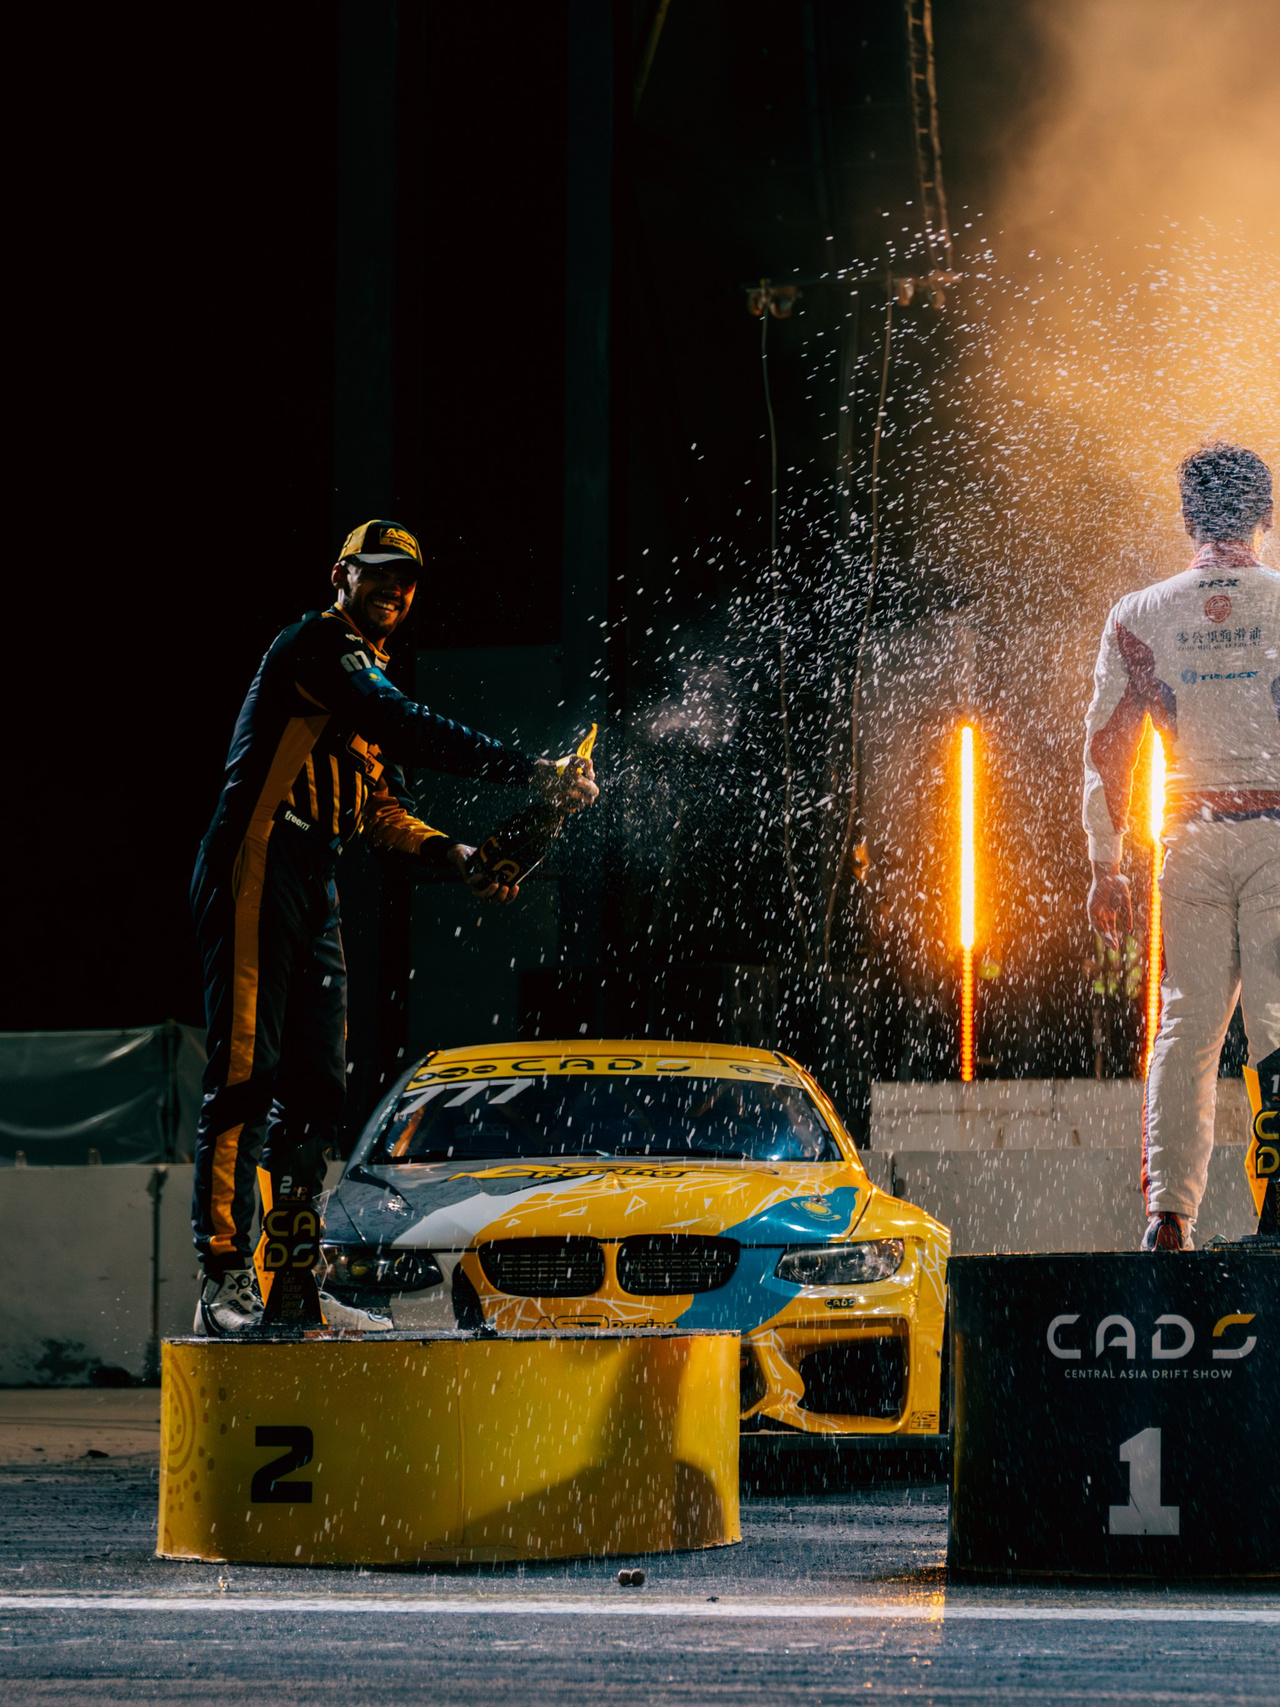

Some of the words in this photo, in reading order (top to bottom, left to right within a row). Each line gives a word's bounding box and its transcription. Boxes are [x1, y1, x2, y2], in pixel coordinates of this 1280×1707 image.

[511, 1058, 691, 1073] CADS
[399, 1078, 536, 1115] 777
[825, 1299, 856, 1307] CADS
[1046, 1313, 1258, 1359] CADS
[1064, 1369, 1115, 1379] CENTRAL
[1119, 1369, 1148, 1379] ASIA
[1151, 1369, 1189, 1379] DRIFT
[1192, 1369, 1233, 1379] SHOW
[249, 1425, 313, 1504] 2
[1108, 1427, 1180, 1536] 1
